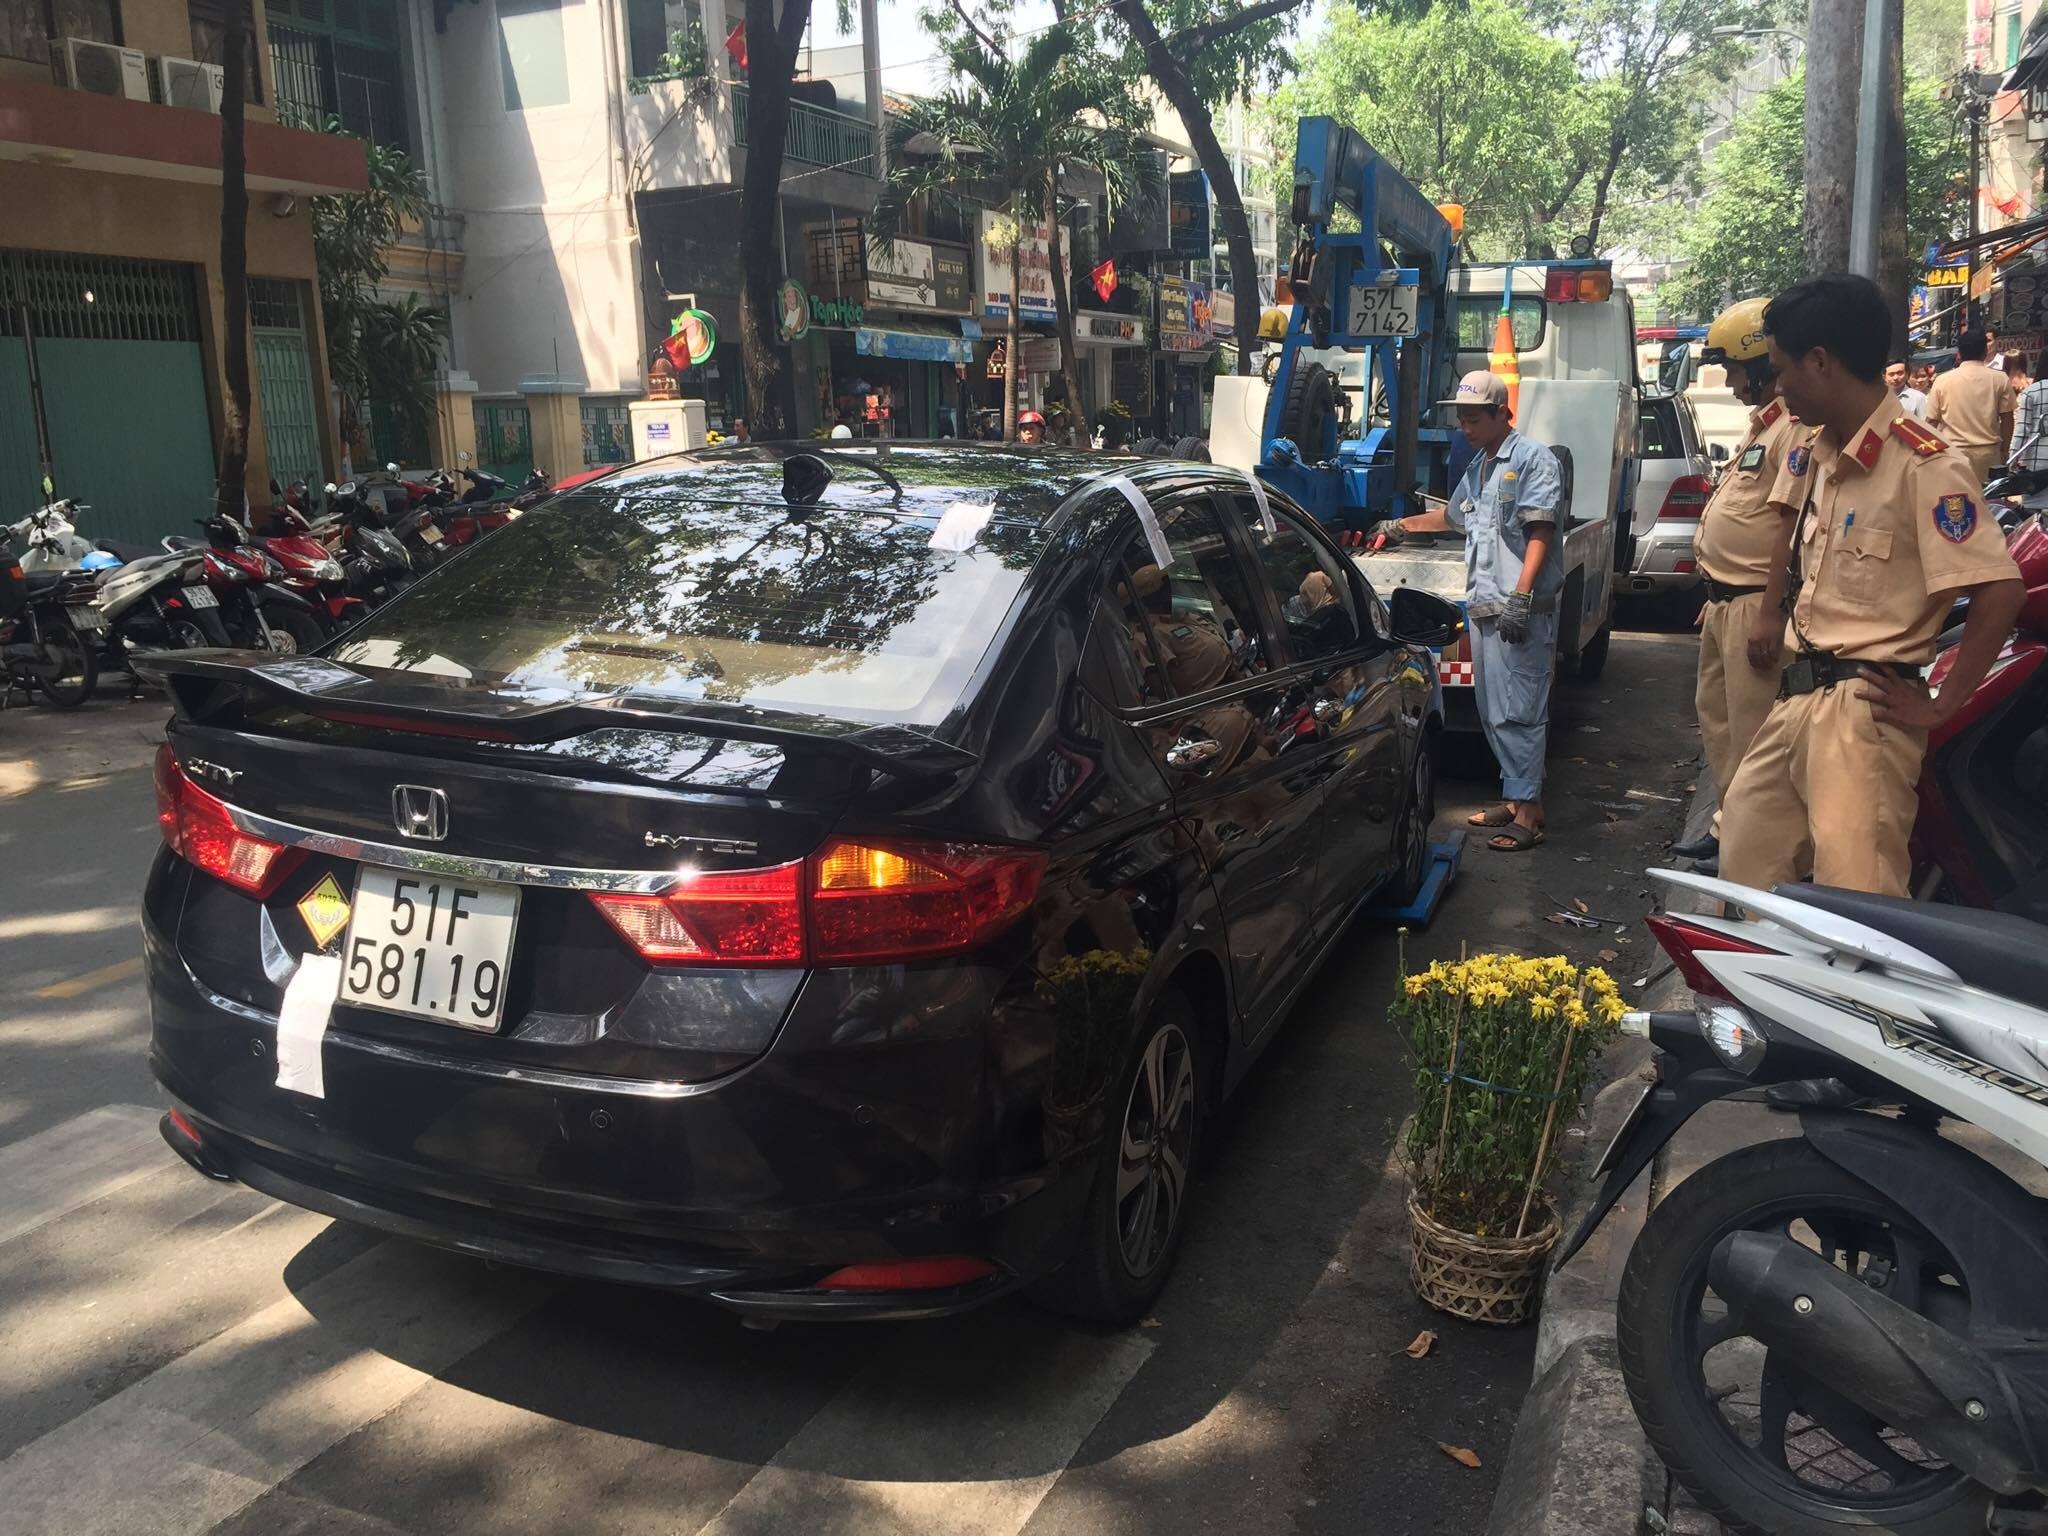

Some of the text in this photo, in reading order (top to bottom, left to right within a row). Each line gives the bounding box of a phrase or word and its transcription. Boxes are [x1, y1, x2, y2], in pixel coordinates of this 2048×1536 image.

[938, 262, 963, 275] CAFE 107
[1363, 288, 1403, 311] 57L
[1355, 311, 1409, 334] 7142
[390, 878, 478, 947] 51F
[348, 936, 501, 1018] 581.19
